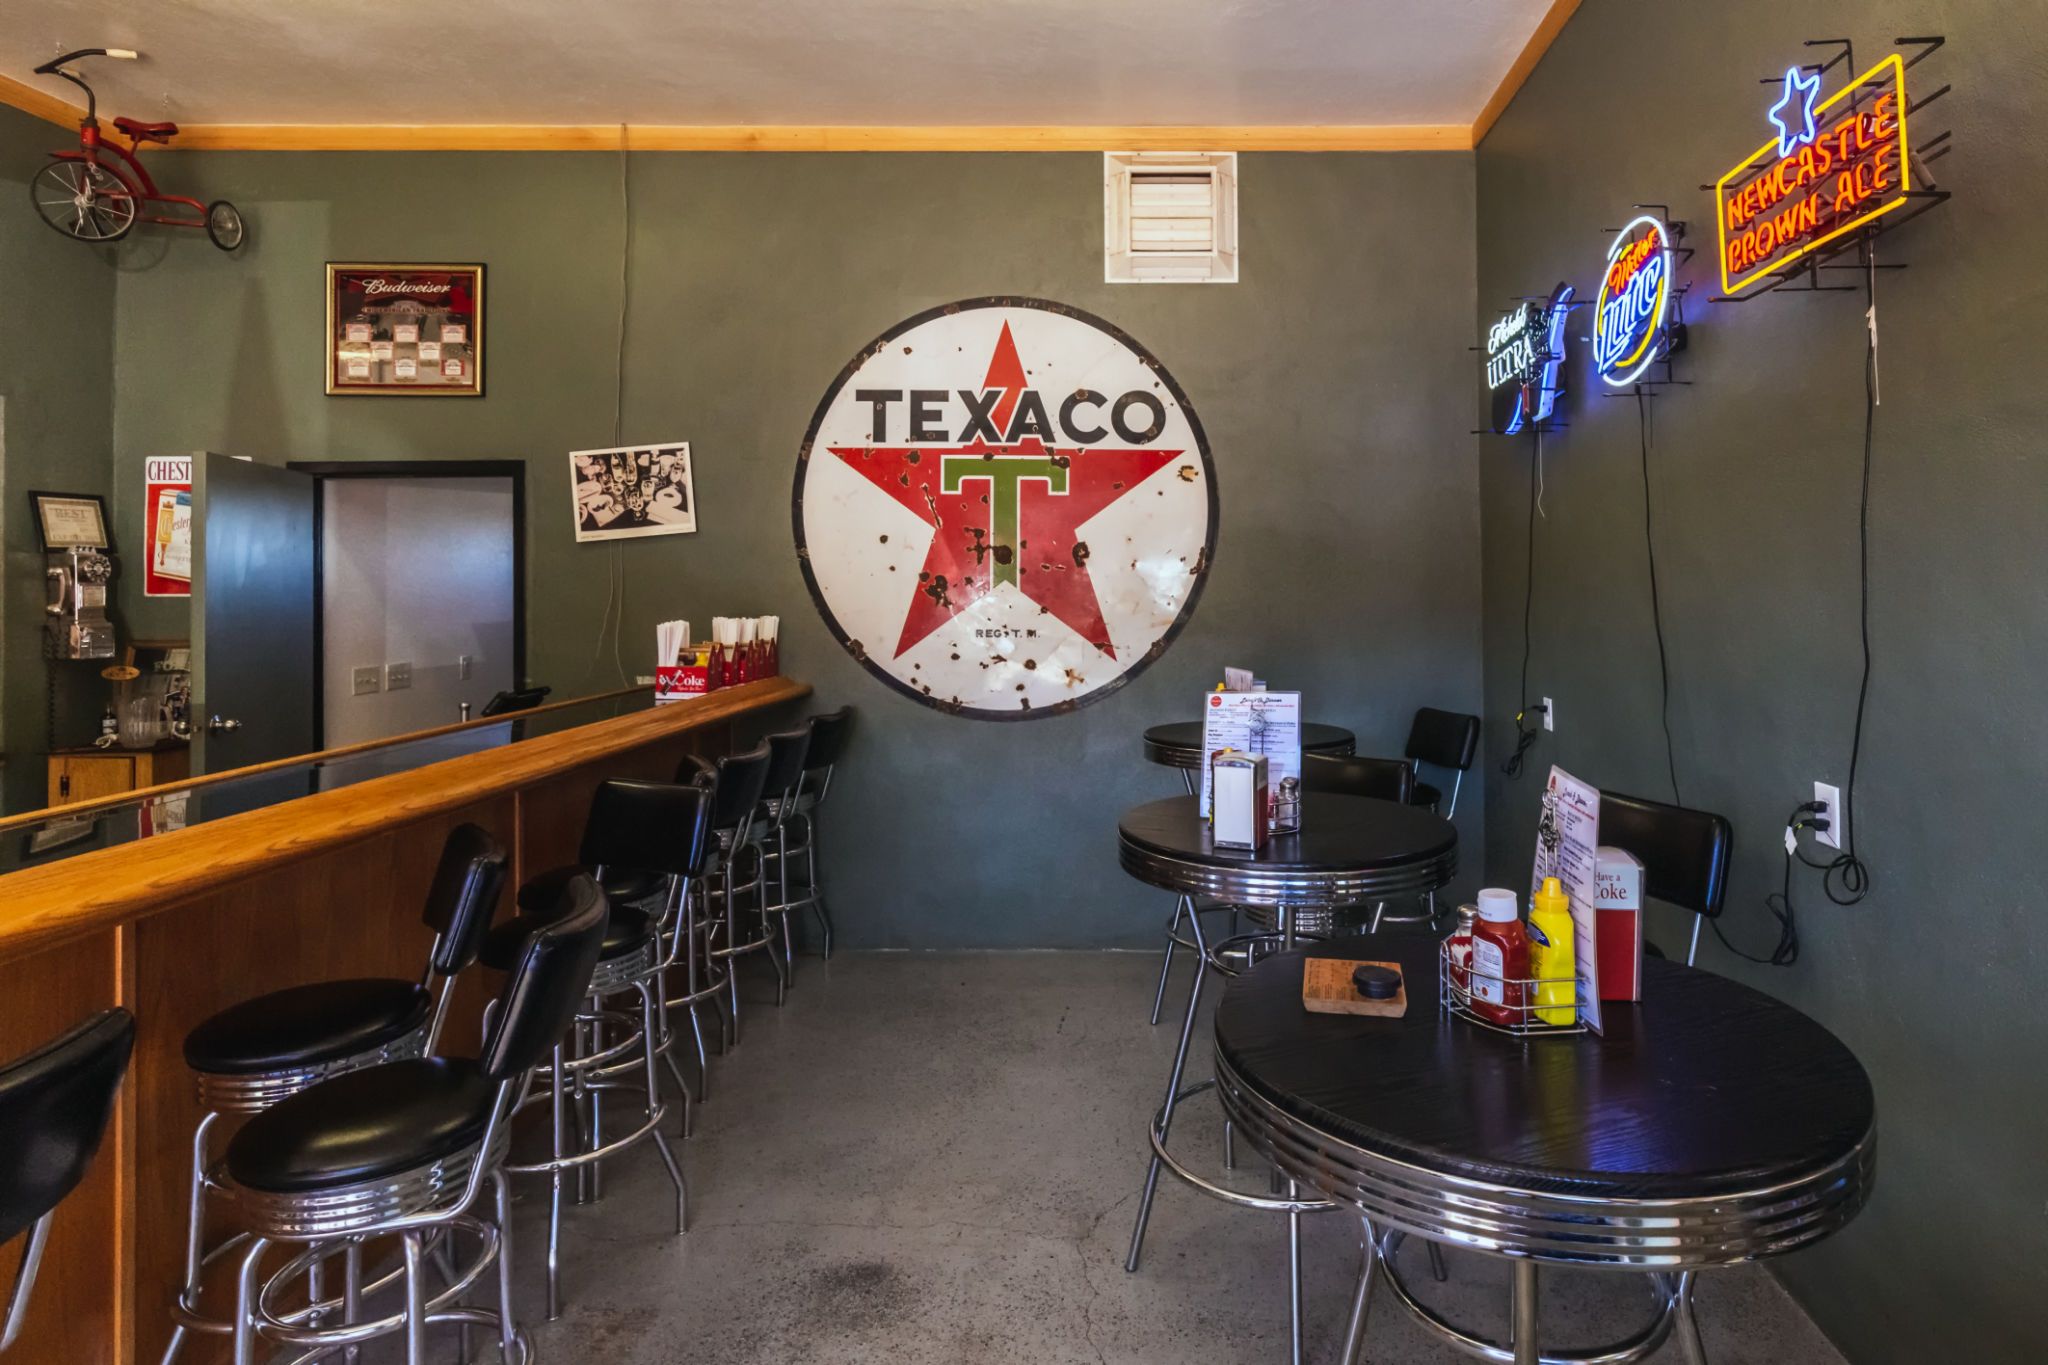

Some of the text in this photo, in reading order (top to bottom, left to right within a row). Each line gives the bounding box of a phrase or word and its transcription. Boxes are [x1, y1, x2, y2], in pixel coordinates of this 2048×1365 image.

[1727, 92, 1893, 230] NEWCASTLE
[1835, 144, 1892, 211] ALE
[362, 279, 451, 294] Budweiser
[1608, 226, 1658, 295] Miller
[1486, 334, 1536, 389] ULTRA
[855, 389, 1167, 445] TEXACO
